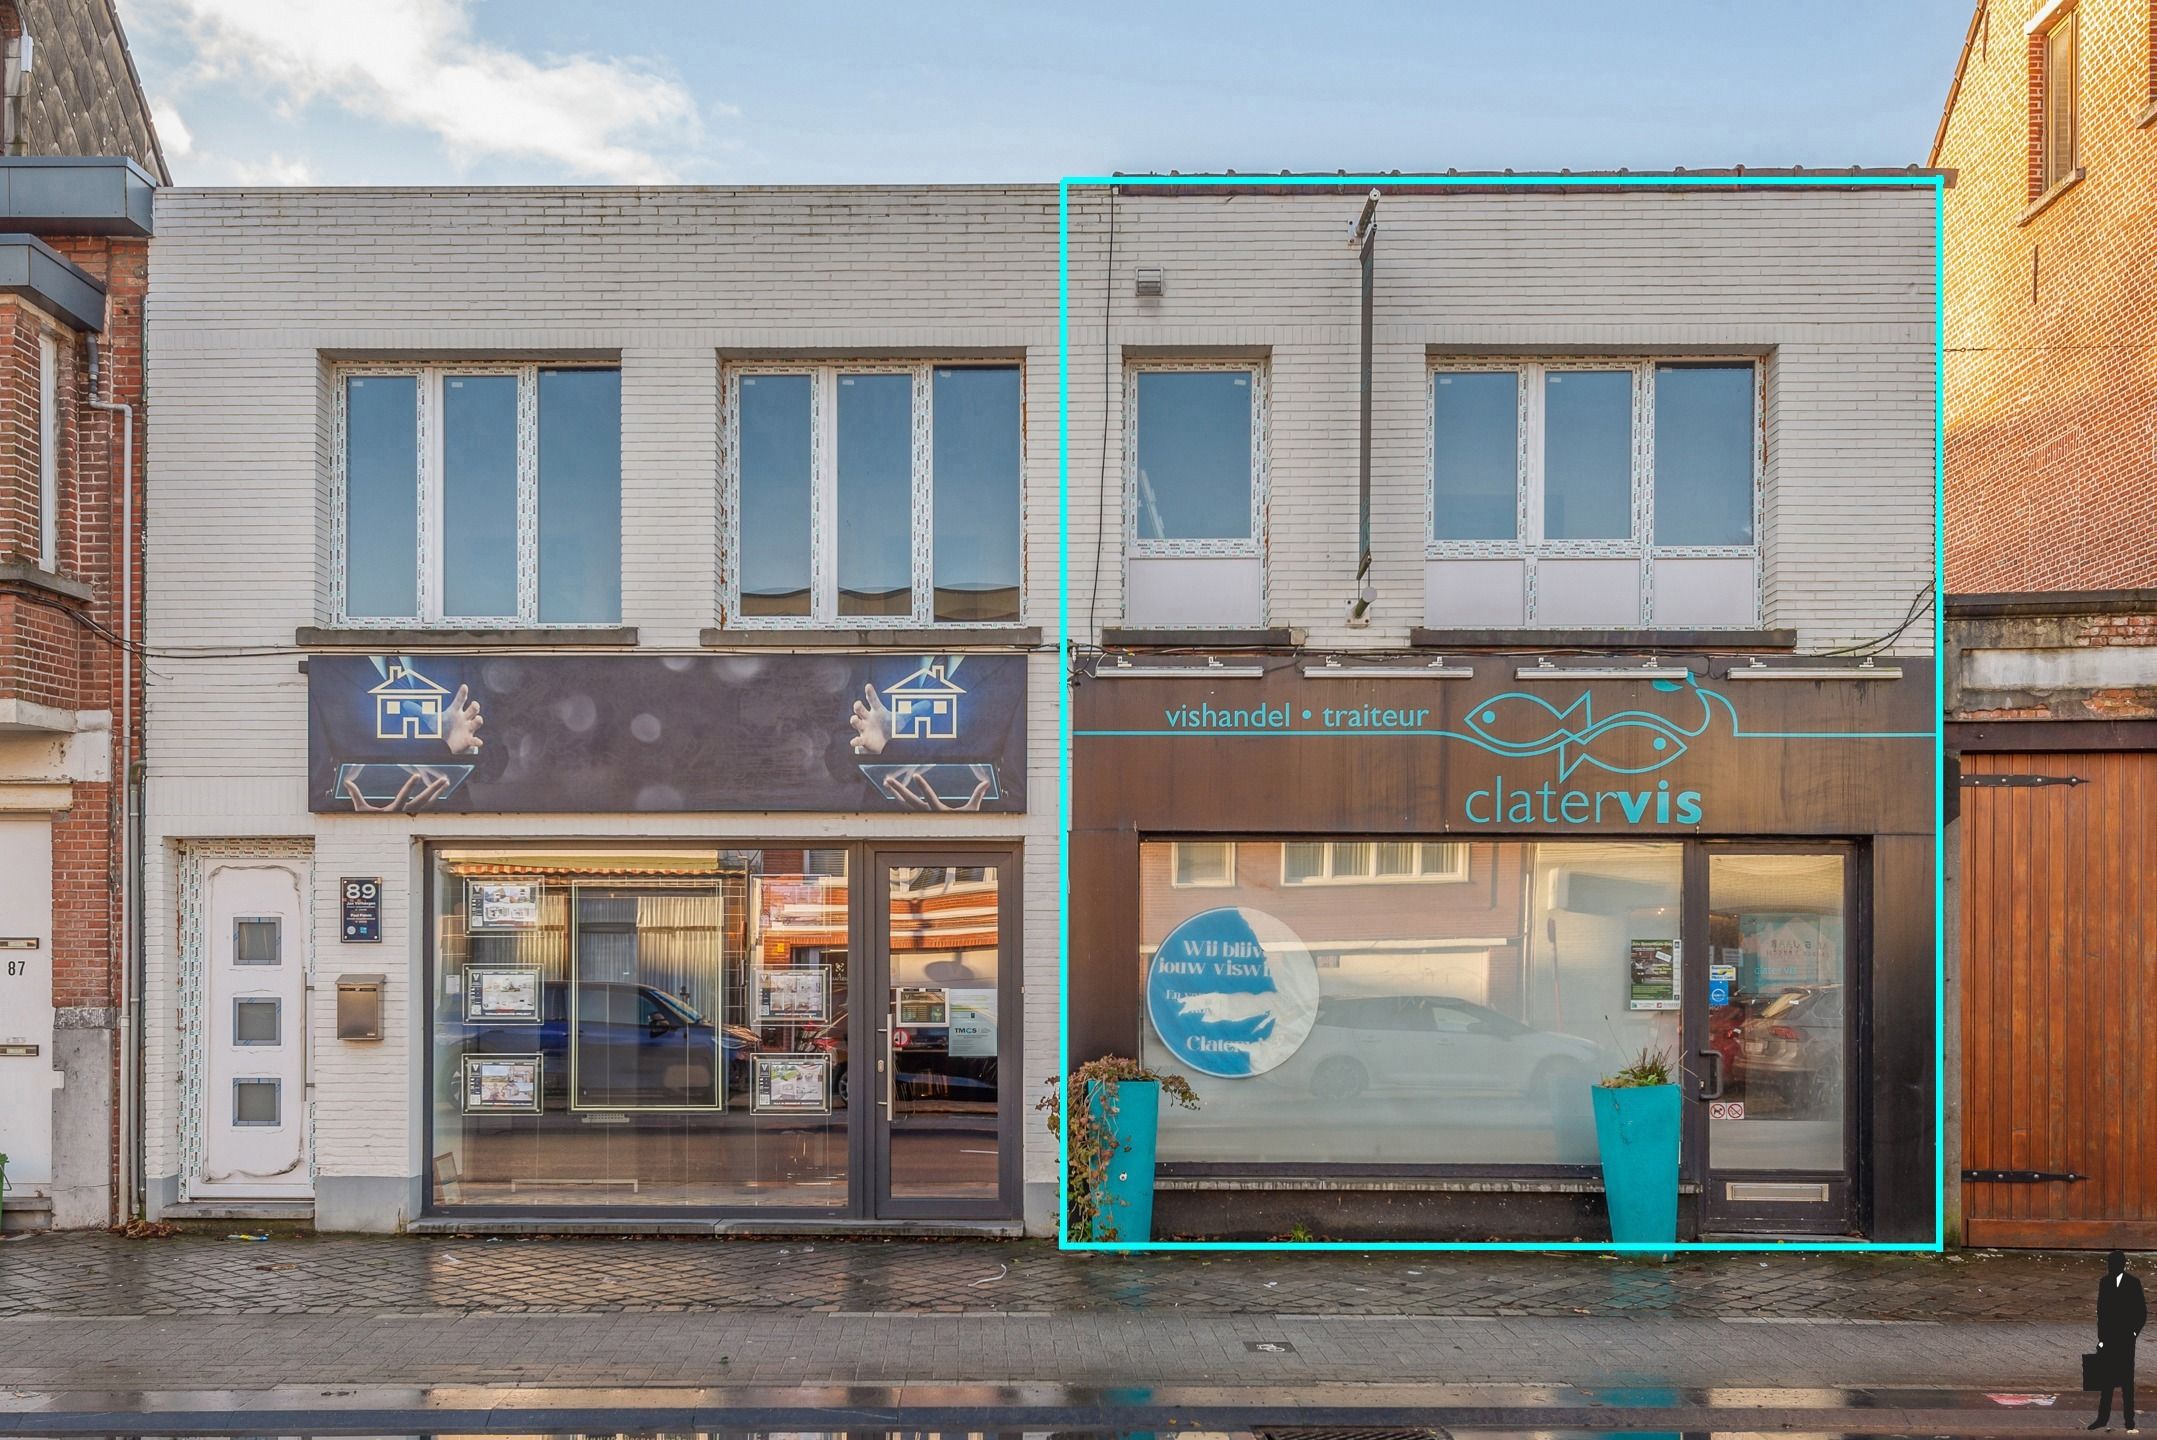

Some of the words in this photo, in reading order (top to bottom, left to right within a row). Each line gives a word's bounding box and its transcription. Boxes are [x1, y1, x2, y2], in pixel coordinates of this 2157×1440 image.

[1165, 702, 1291, 728] vishandel
[1322, 703, 1430, 728] traiteur
[1464, 775, 1704, 825] clatervis
[345, 883, 377, 899] 89
[1183, 940, 1219, 958] Wij
[8, 960, 26, 976] 87
